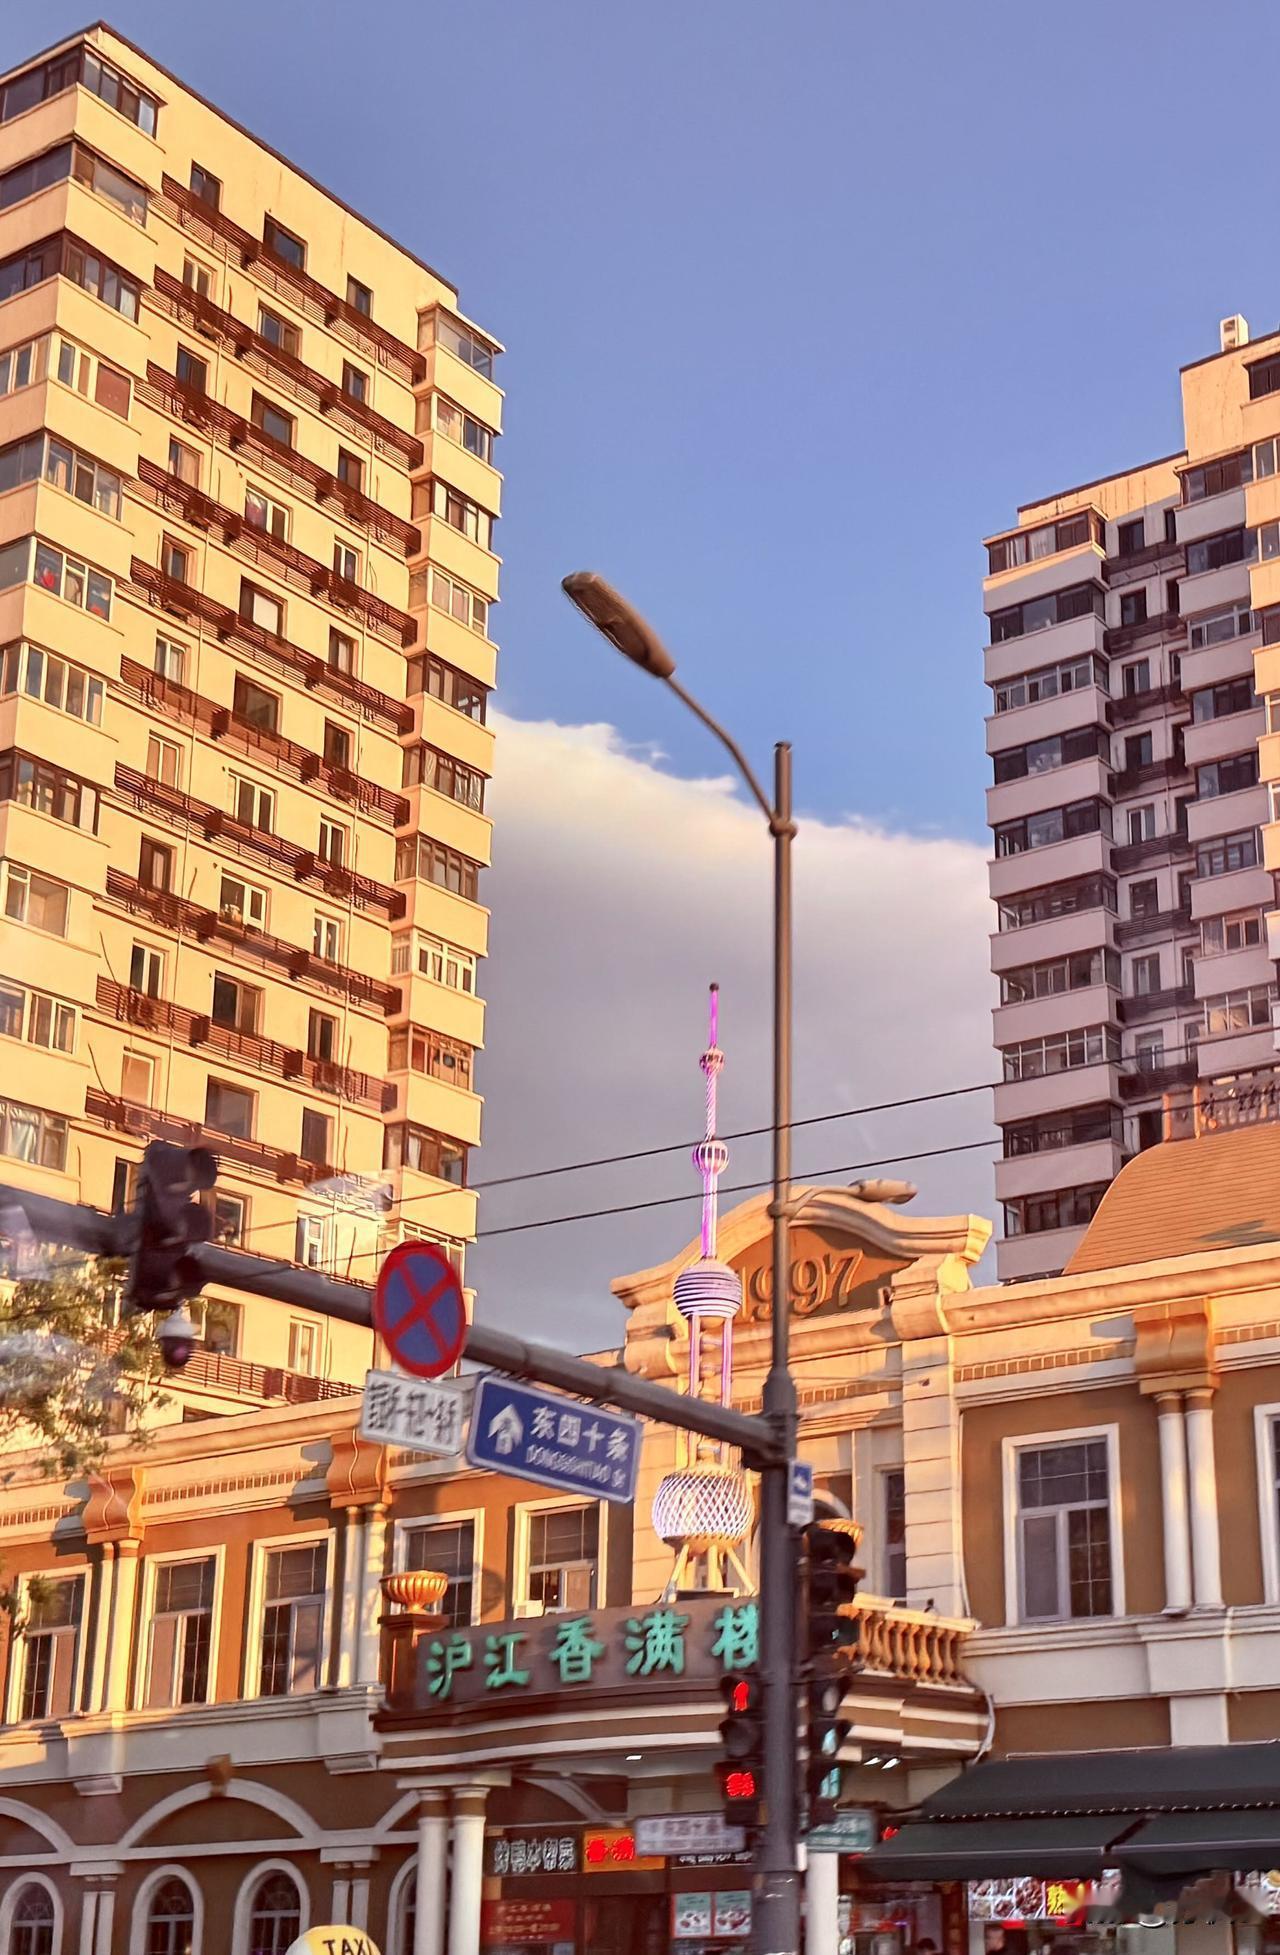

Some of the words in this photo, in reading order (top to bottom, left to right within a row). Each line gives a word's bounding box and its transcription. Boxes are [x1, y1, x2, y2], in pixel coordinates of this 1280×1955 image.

[740, 1249, 864, 1320] 1997
[530, 1405, 630, 1463] 东四十条
[426, 1604, 759, 1699] 沪江香满楼
